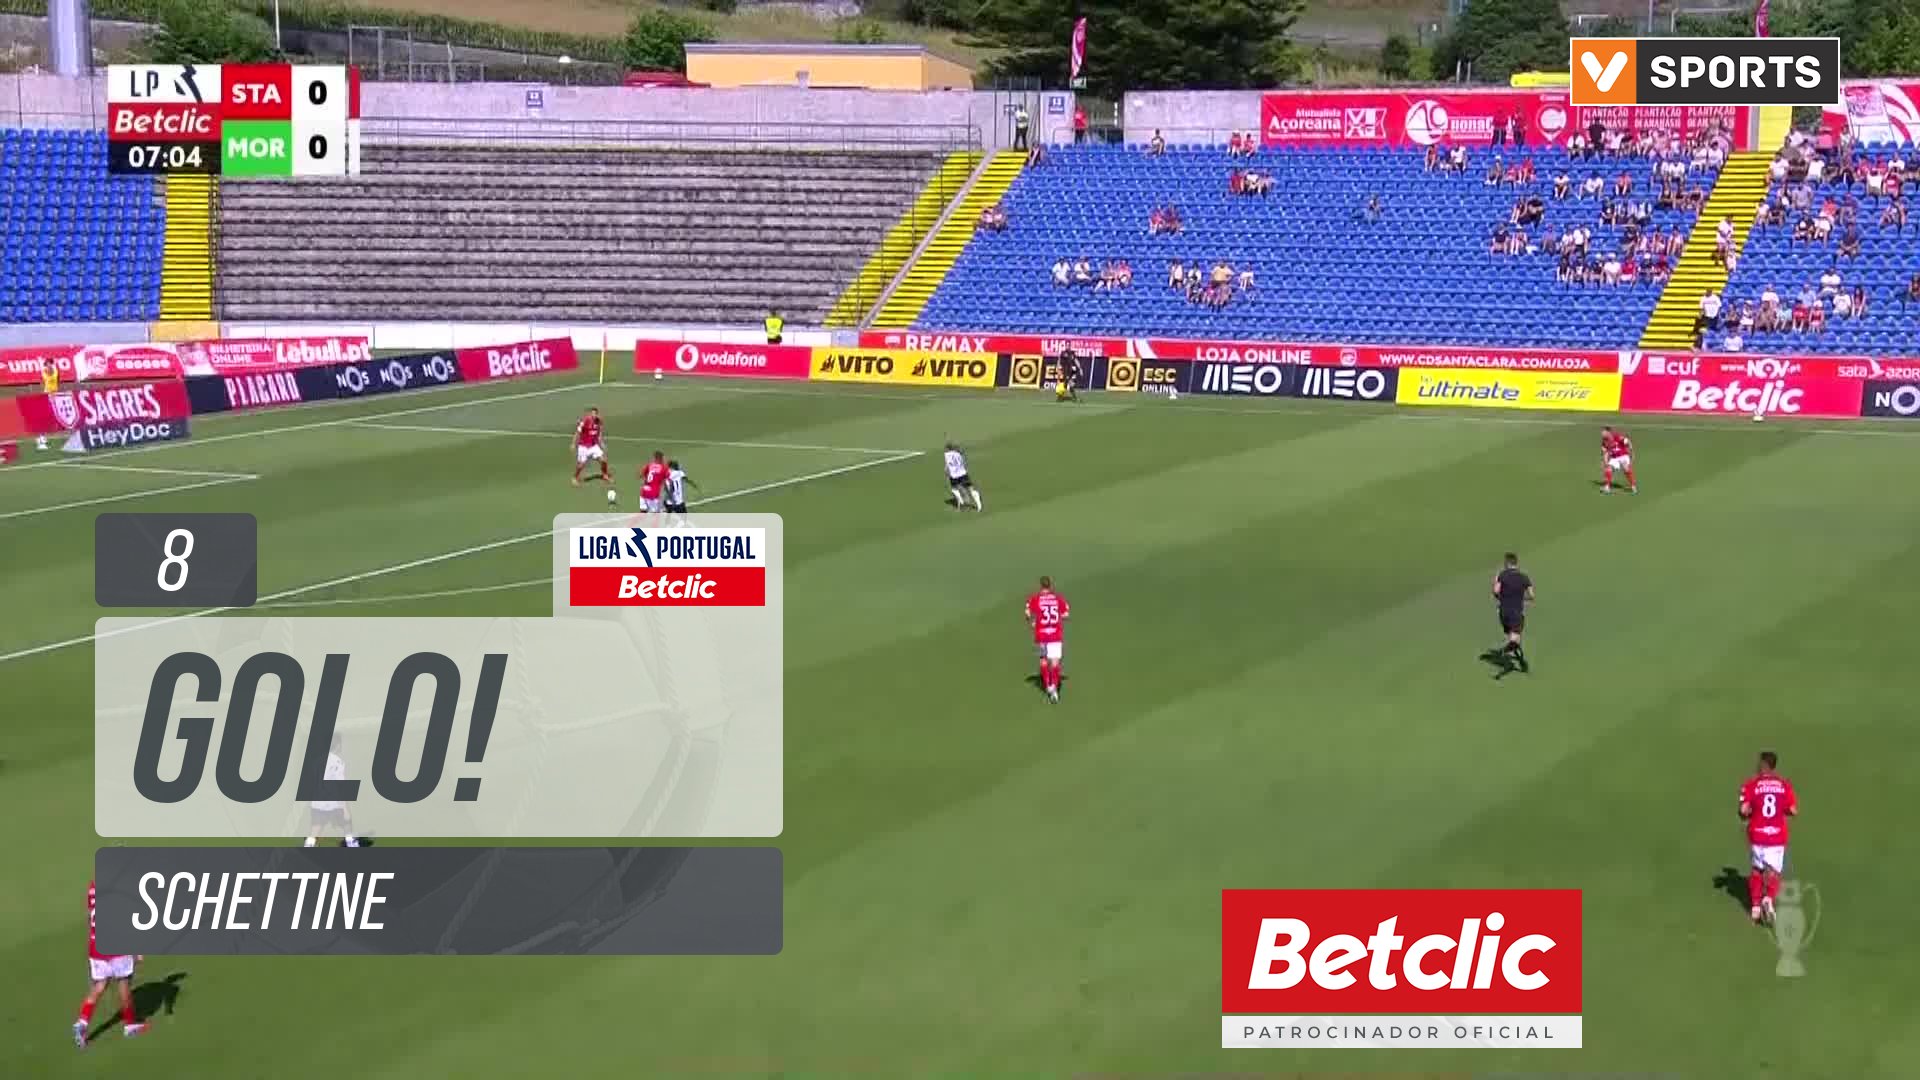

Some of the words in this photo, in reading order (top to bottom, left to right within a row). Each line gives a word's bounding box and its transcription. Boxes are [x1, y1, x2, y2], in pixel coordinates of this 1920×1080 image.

[1268, 115, 1341, 133] Açoreana
[906, 335, 986, 352] RE/MAX
[488, 343, 553, 377] Betclic
[702, 351, 766, 367] vodafone
[838, 356, 894, 375] VITO
[1196, 348, 1240, 362] LOJA
[1244, 350, 1312, 365] ONLINE
[1379, 354, 1591, 369] WWW.CDSANTACLARA.COM/LOJA
[379, 361, 413, 386] NOS
[422, 356, 455, 381] NOS
[930, 359, 987, 378] VITO
[1143, 368, 1177, 383] ESC
[1666, 360, 1700, 376] cuf
[1838, 364, 1868, 378] sata
[336, 366, 370, 392] NOS
[1202, 364, 1282, 394] MEO
[1302, 367, 1385, 399] MEO
[1418, 381, 1520, 401] ultimate
[1671, 380, 1804, 415] Betclic
[79, 384, 161, 425] SAGRES
[88, 423, 170, 447] HeyDoc
[1040, 605, 1059, 624] 35
[1761, 794, 1777, 818] 8
